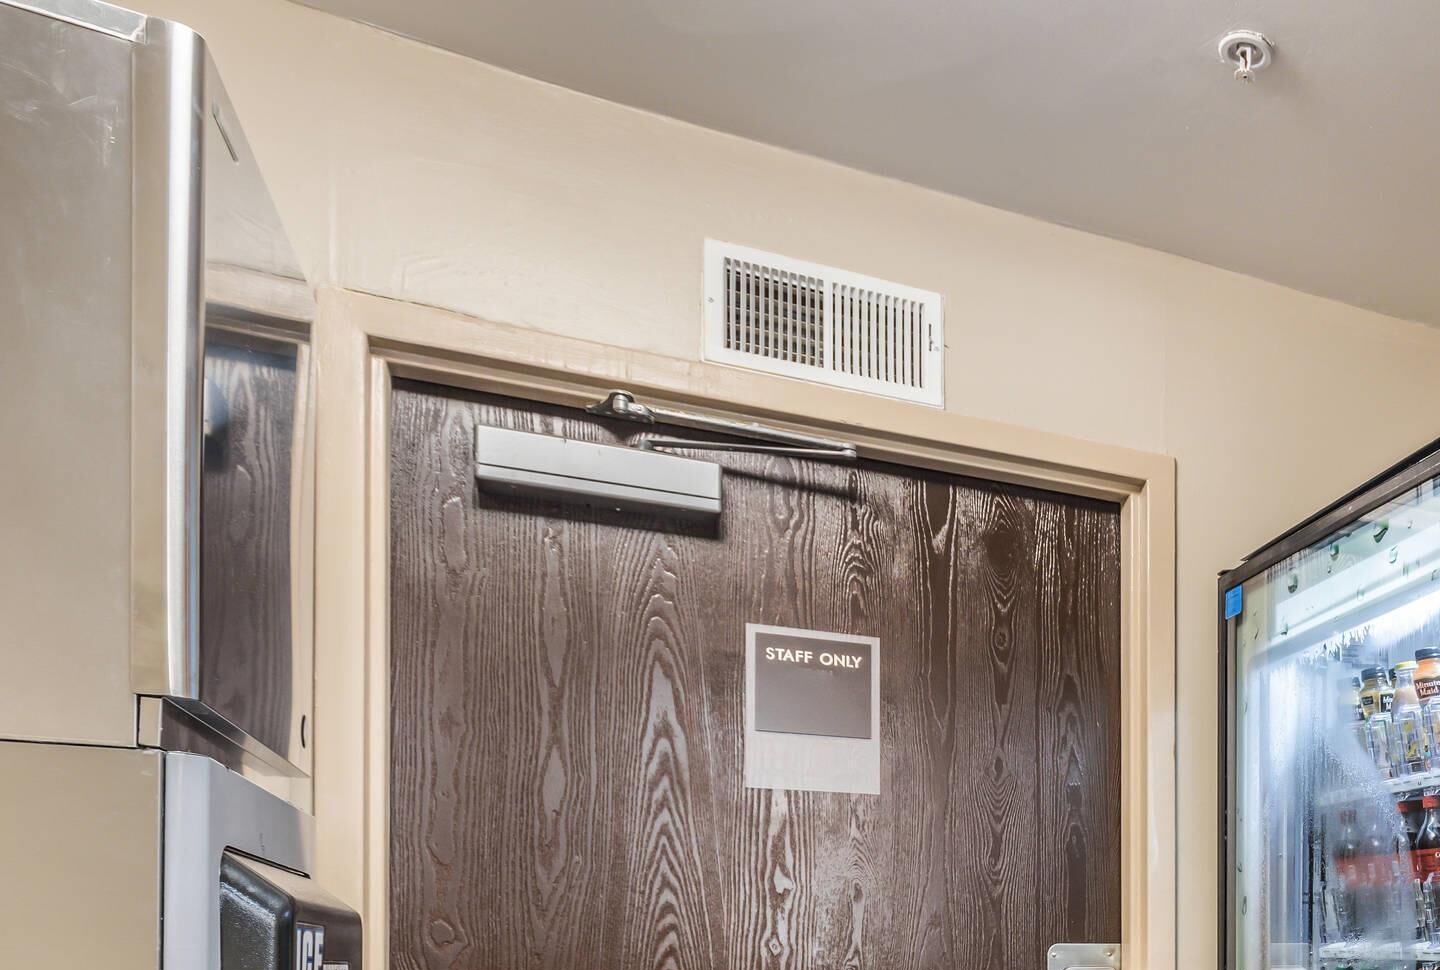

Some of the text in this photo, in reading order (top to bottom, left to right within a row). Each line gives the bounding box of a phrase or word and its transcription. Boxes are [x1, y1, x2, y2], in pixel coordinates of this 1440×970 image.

[766, 647, 862, 668] STAFF ONLY
[1420, 688, 1438, 696] Maid
